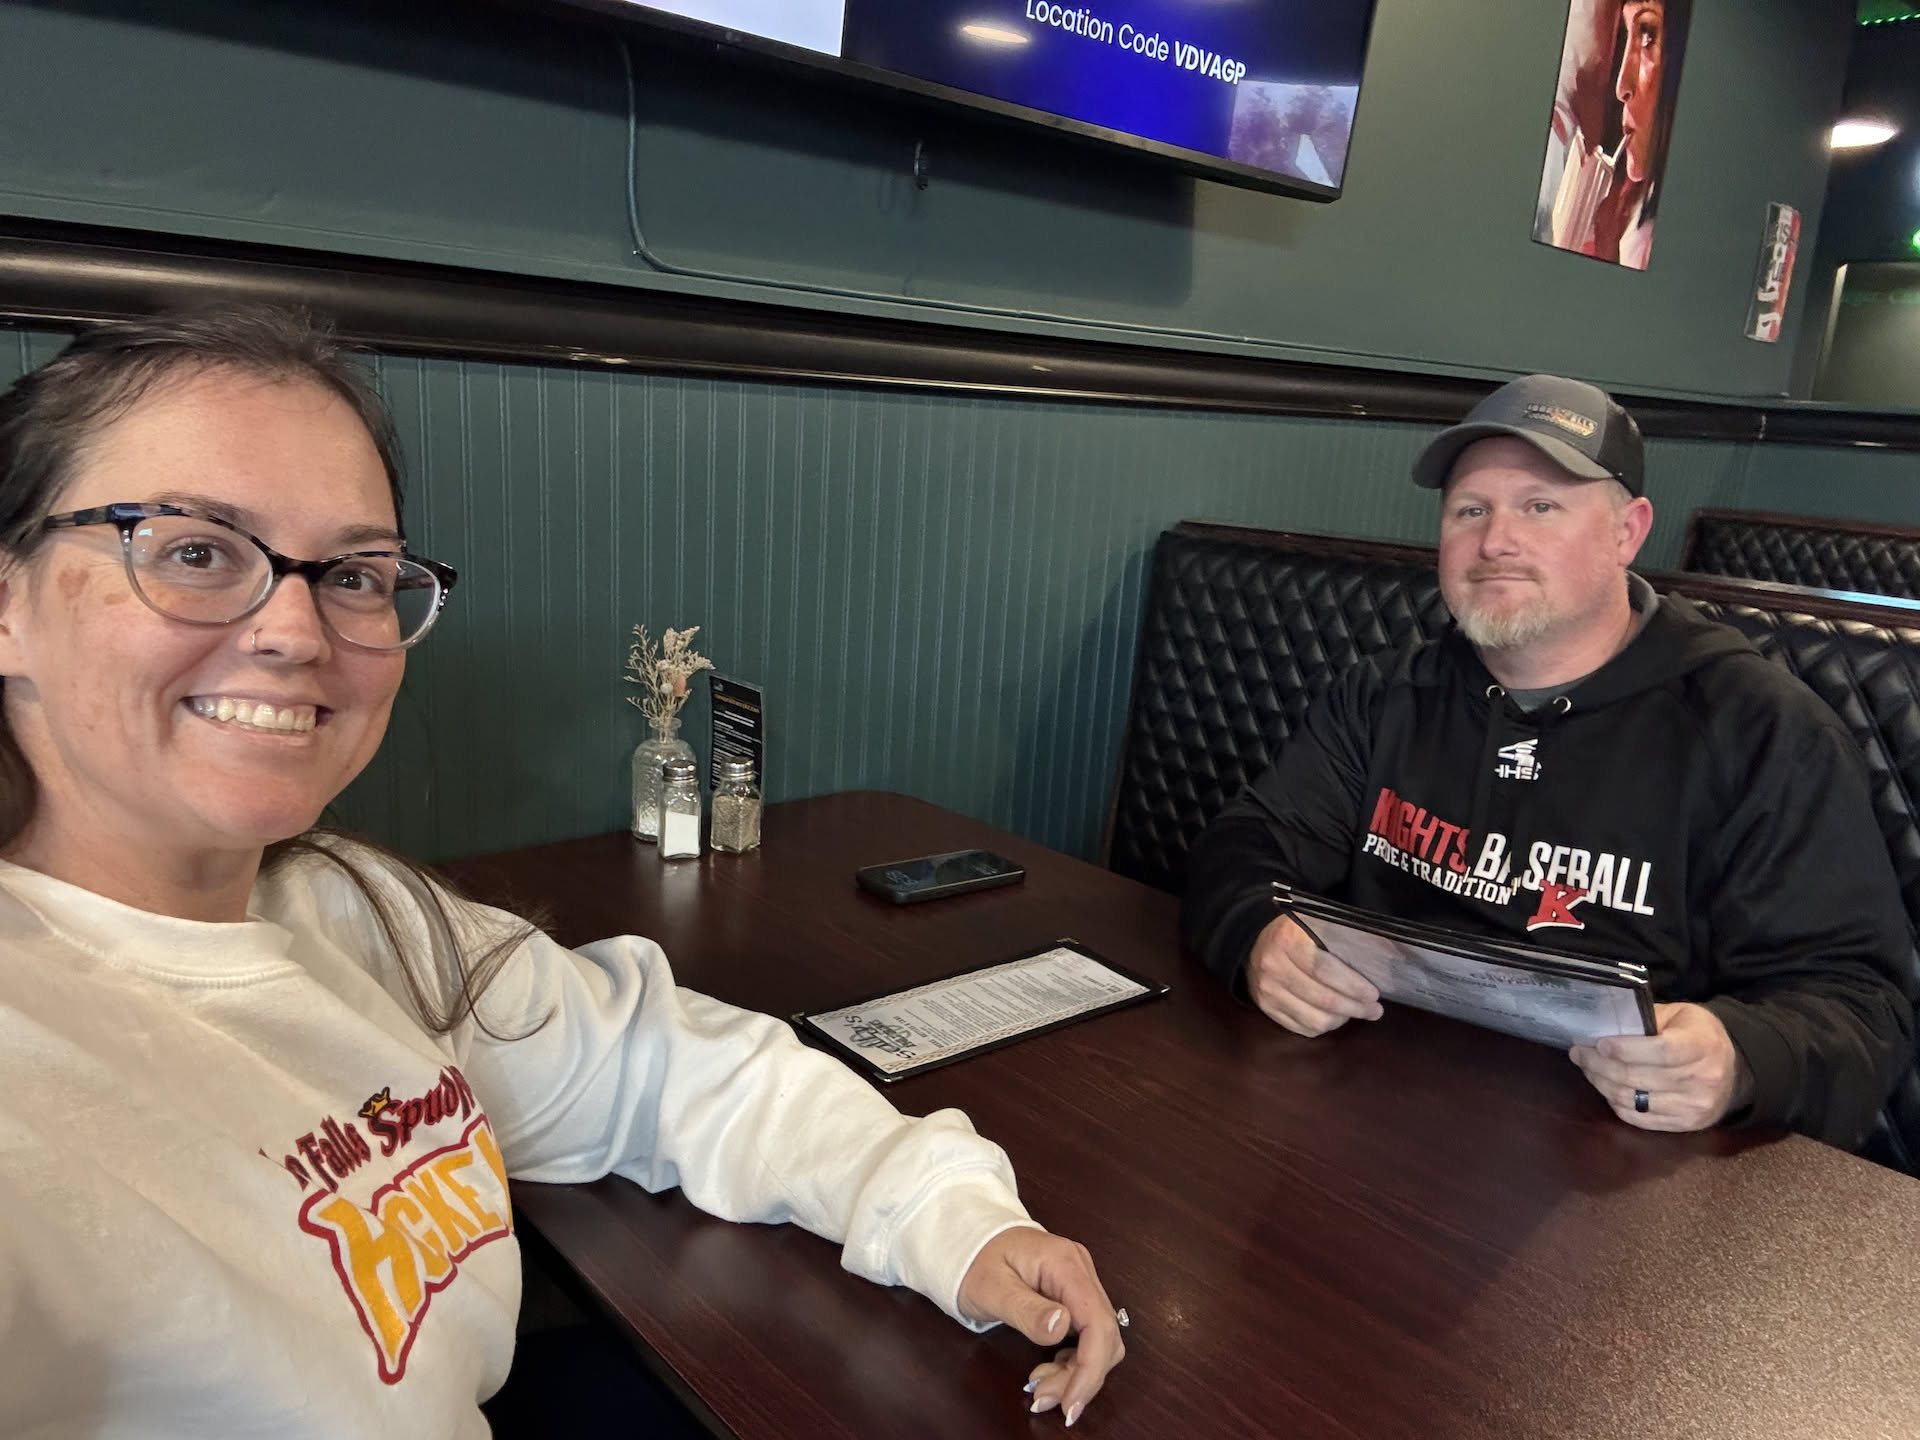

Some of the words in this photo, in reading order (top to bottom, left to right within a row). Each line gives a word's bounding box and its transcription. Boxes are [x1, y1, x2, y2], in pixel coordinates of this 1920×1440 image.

[1025, 0, 1113, 44] Location
[1118, 23, 1170, 61] Code
[1174, 40, 1247, 85] VDVAGP
[1362, 833, 1400, 867] PRDE
[1400, 851, 1410, 873] &
[1411, 856, 1513, 906] TRADITION
[1369, 787, 1470, 873] KIGHTS
[1526, 876, 1588, 932] K
